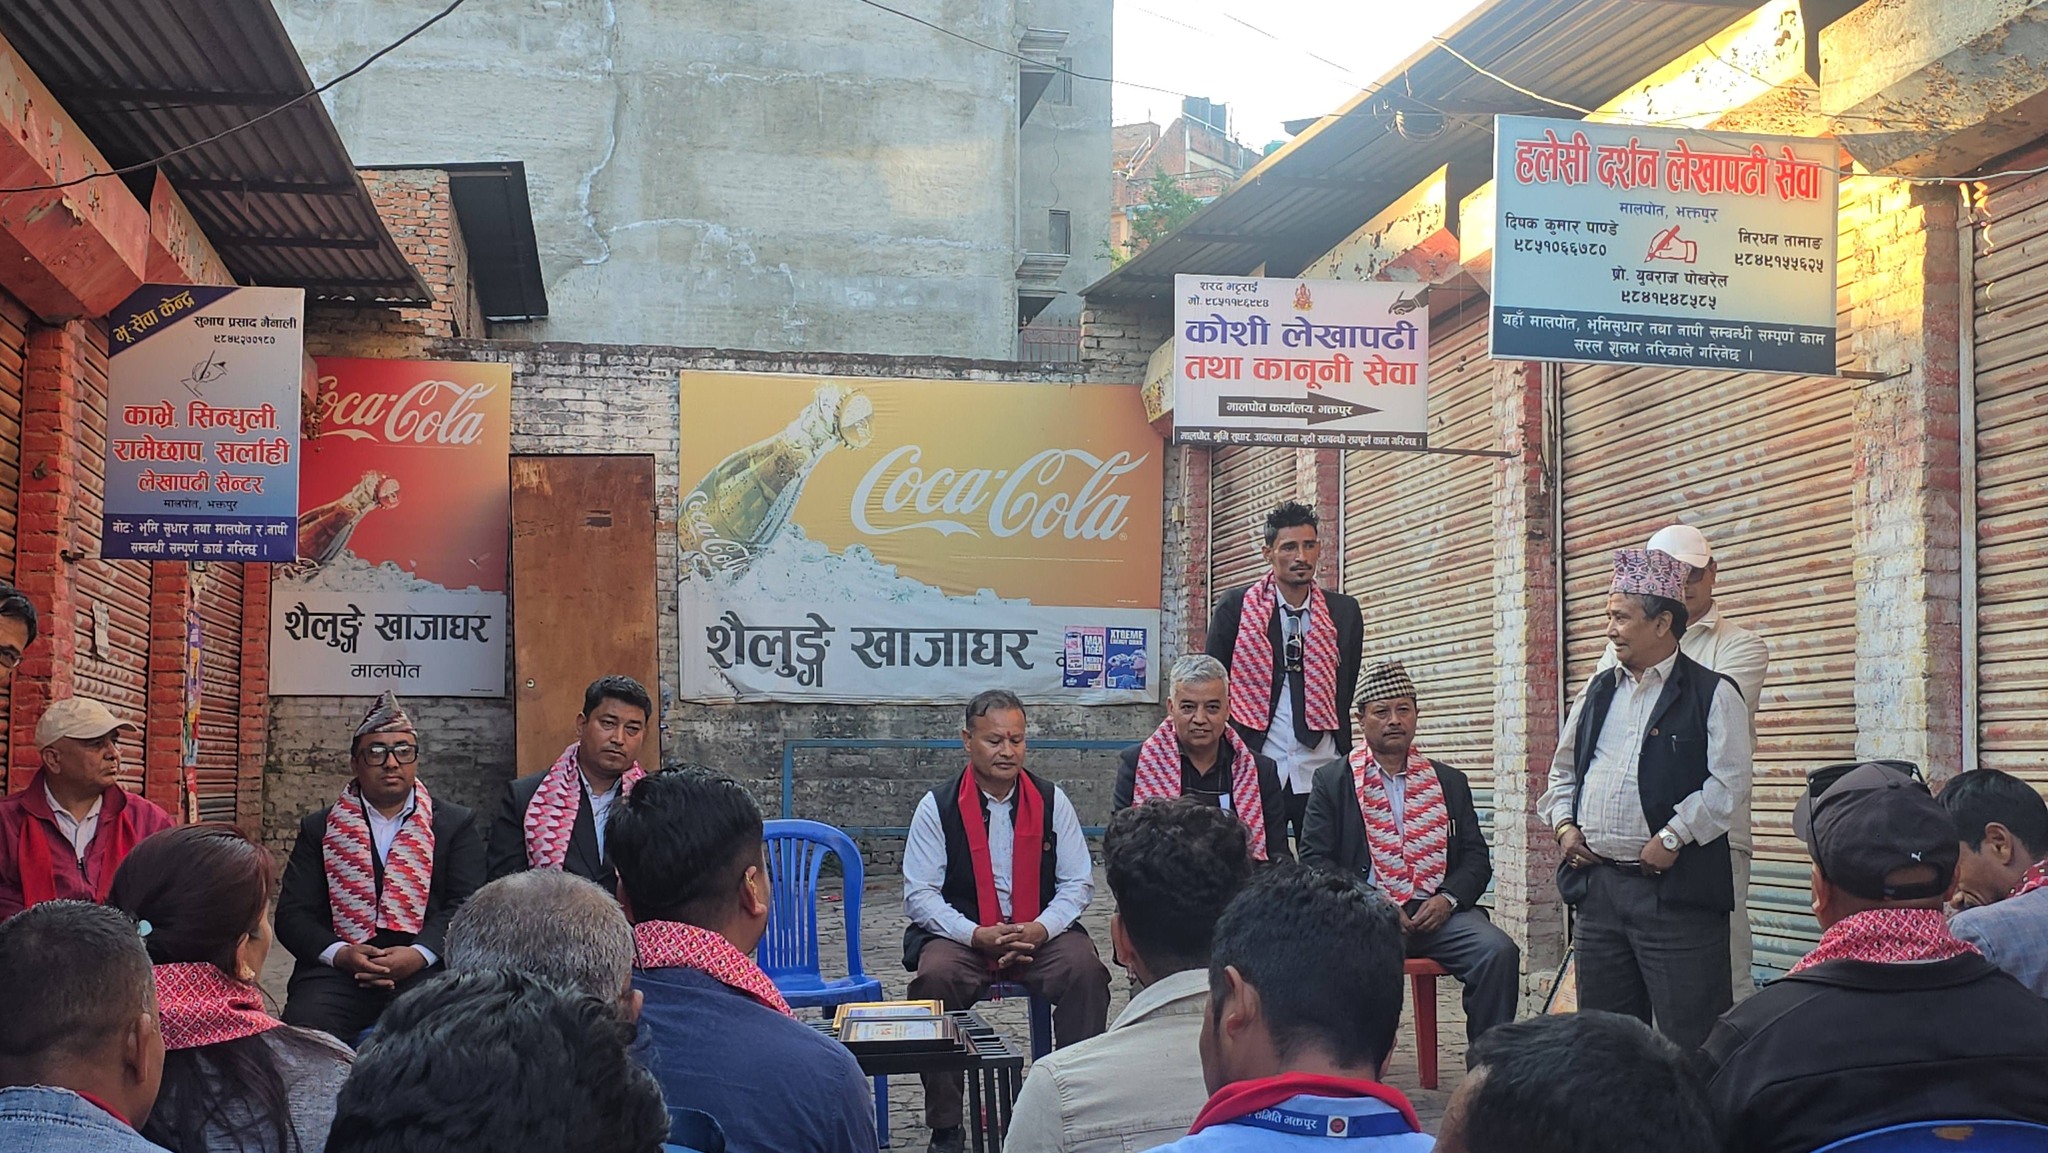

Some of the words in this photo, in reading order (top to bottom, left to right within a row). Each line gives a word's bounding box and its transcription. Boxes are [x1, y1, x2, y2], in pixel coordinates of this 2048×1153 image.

[1515, 130, 1591, 185] हलेसी
[1597, 140, 1659, 189] दर्शन
[1665, 140, 1769, 196] लेखापढी
[1773, 145, 1823, 200] सेवा
[1505, 211, 1539, 230] दिपक
[1545, 218, 1581, 235] कुमार
[1586, 219, 1619, 236] पाण्डे
[1619, 202, 1669, 219] मालपोत,
[1676, 204, 1719, 223] भक्तपुर
[1514, 238, 1607, 256] ९८५१०६६७८०
[1738, 227, 1779, 247] निरधन
[1734, 253, 1824, 273] ९८४९१५५६२५
[1200, 281, 1223, 291] शरद
[1611, 265, 1629, 281] प्रो.
[1684, 270, 1728, 288] पोखरेल
[158, 290, 195, 318] केन्द्र
[1621, 290, 1717, 310] ९८४१९४८५८५
[228, 317, 257, 329] प्रसाद
[1185, 313, 1271, 347] कोशी
[1281, 316, 1419, 350] लेखापढी
[1502, 309, 1524, 329] यहाँ
[1530, 314, 1580, 333] मालपोत,
[1649, 323, 1673, 336] तथा
[1677, 322, 1704, 338] नापी
[1758, 328, 1795, 346] सम्पूर्ण
[1799, 332, 1827, 346] काम
[1574, 338, 1603, 354] सरल
[1645, 341, 1694, 359] तरिकाले
[1699, 342, 1742, 362] गरिनेछ
[1184, 355, 1244, 380] तथा
[1253, 353, 1354, 390] कानूनी
[1363, 354, 1419, 386] सेवा
[1226, 401, 1266, 412] मालपोत
[1318, 404, 1353, 417] भक्तपुर
[215, 438, 290, 464] सर्लाही
[138, 469, 209, 492] लेखापढी
[215, 471, 264, 493] सेन्टर
[850, 444, 1150, 541] Coca-Cola
[207, 500, 238, 511] भक्तपुर
[139, 519, 158, 536] भूमि
[193, 524, 211, 535] तथा
[215, 521, 252, 535] मालपोत
[374, 612, 492, 643] खाजाघर
[850, 627, 1039, 671] खाजाघर
[350, 660, 422, 679] मालपोत
